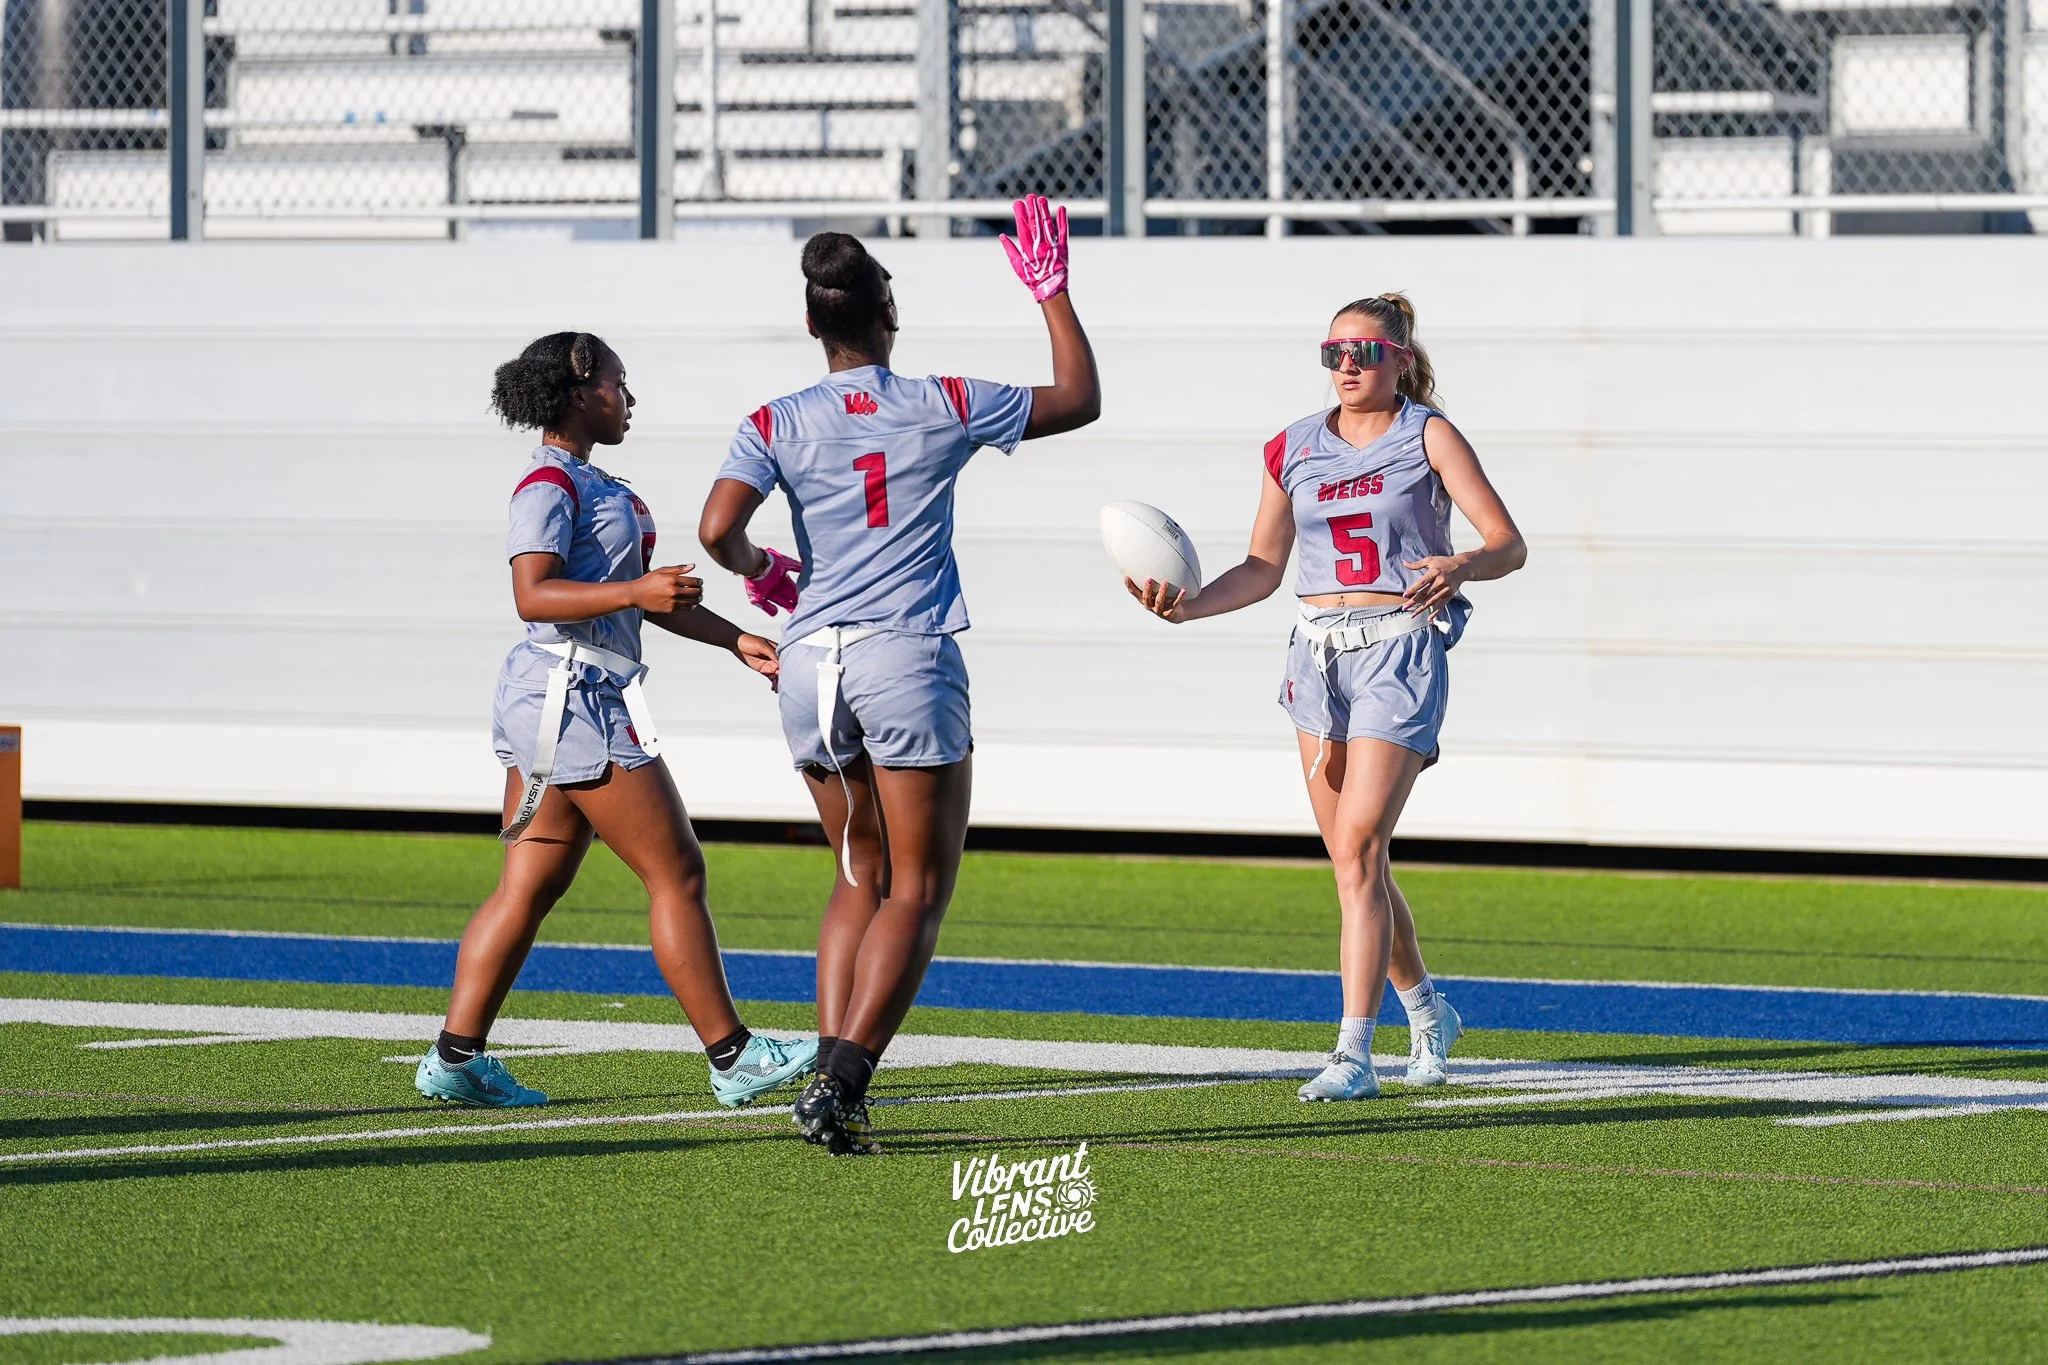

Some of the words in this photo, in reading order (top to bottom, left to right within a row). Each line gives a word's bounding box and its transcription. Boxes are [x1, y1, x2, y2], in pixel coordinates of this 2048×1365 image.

[852, 451, 889, 529] 1
[1317, 473, 1385, 502] WEISS
[1326, 512, 1381, 587] 5
[525, 783, 541, 805] USA
